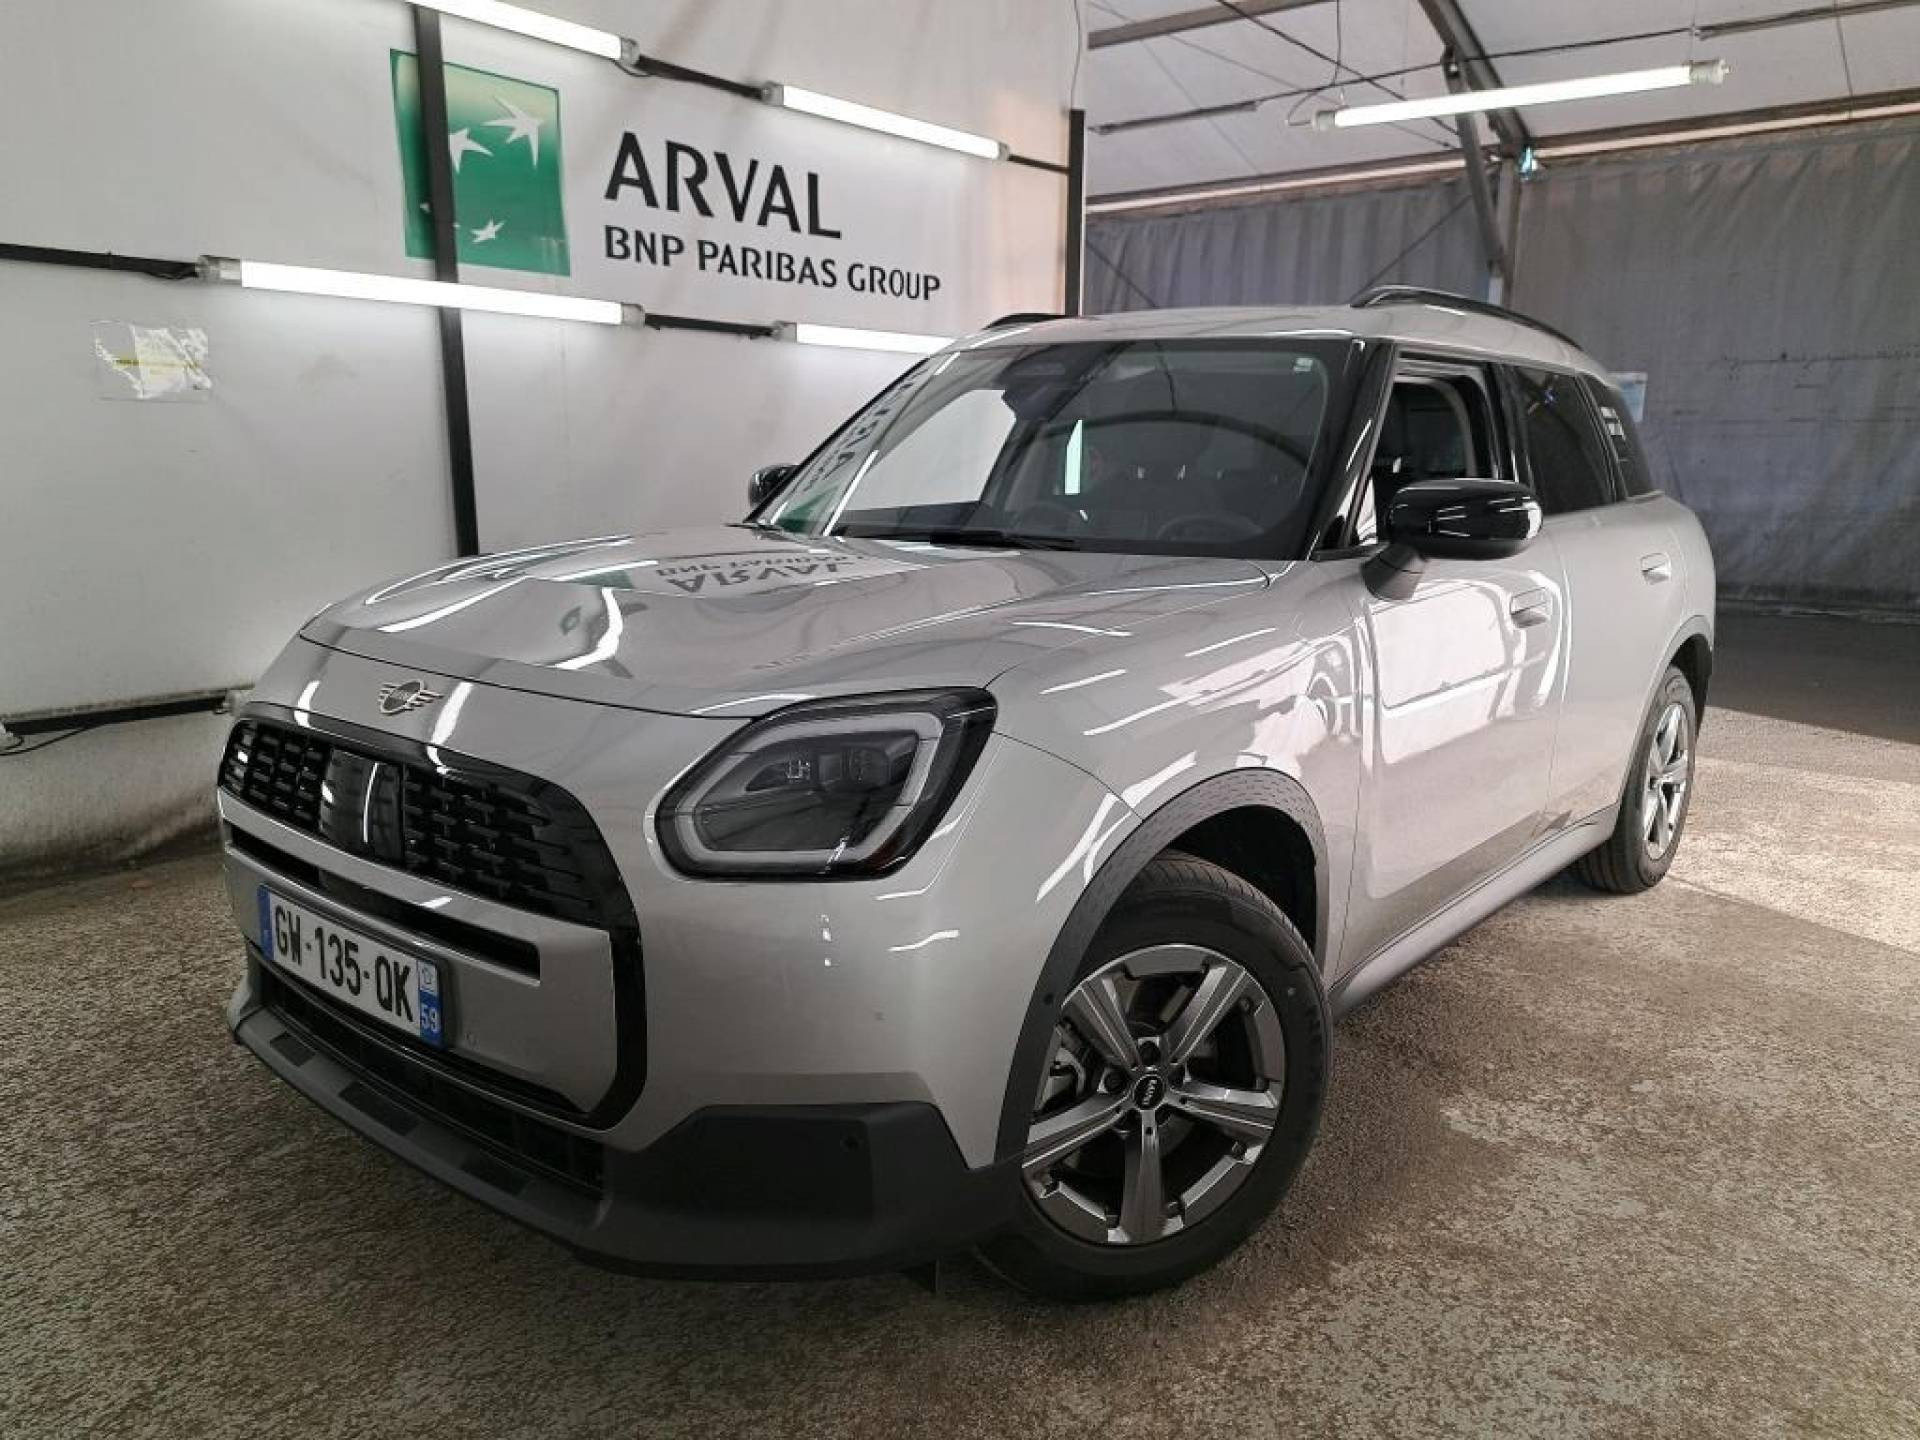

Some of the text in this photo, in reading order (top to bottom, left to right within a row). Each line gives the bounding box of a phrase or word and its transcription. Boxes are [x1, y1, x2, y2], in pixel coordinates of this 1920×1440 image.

[604, 131, 842, 239] ARVAL
[605, 224, 941, 300] BNP PARIBAS GROUP
[275, 904, 414, 1022] GW-135-QK
[420, 1004, 440, 1034] 59
